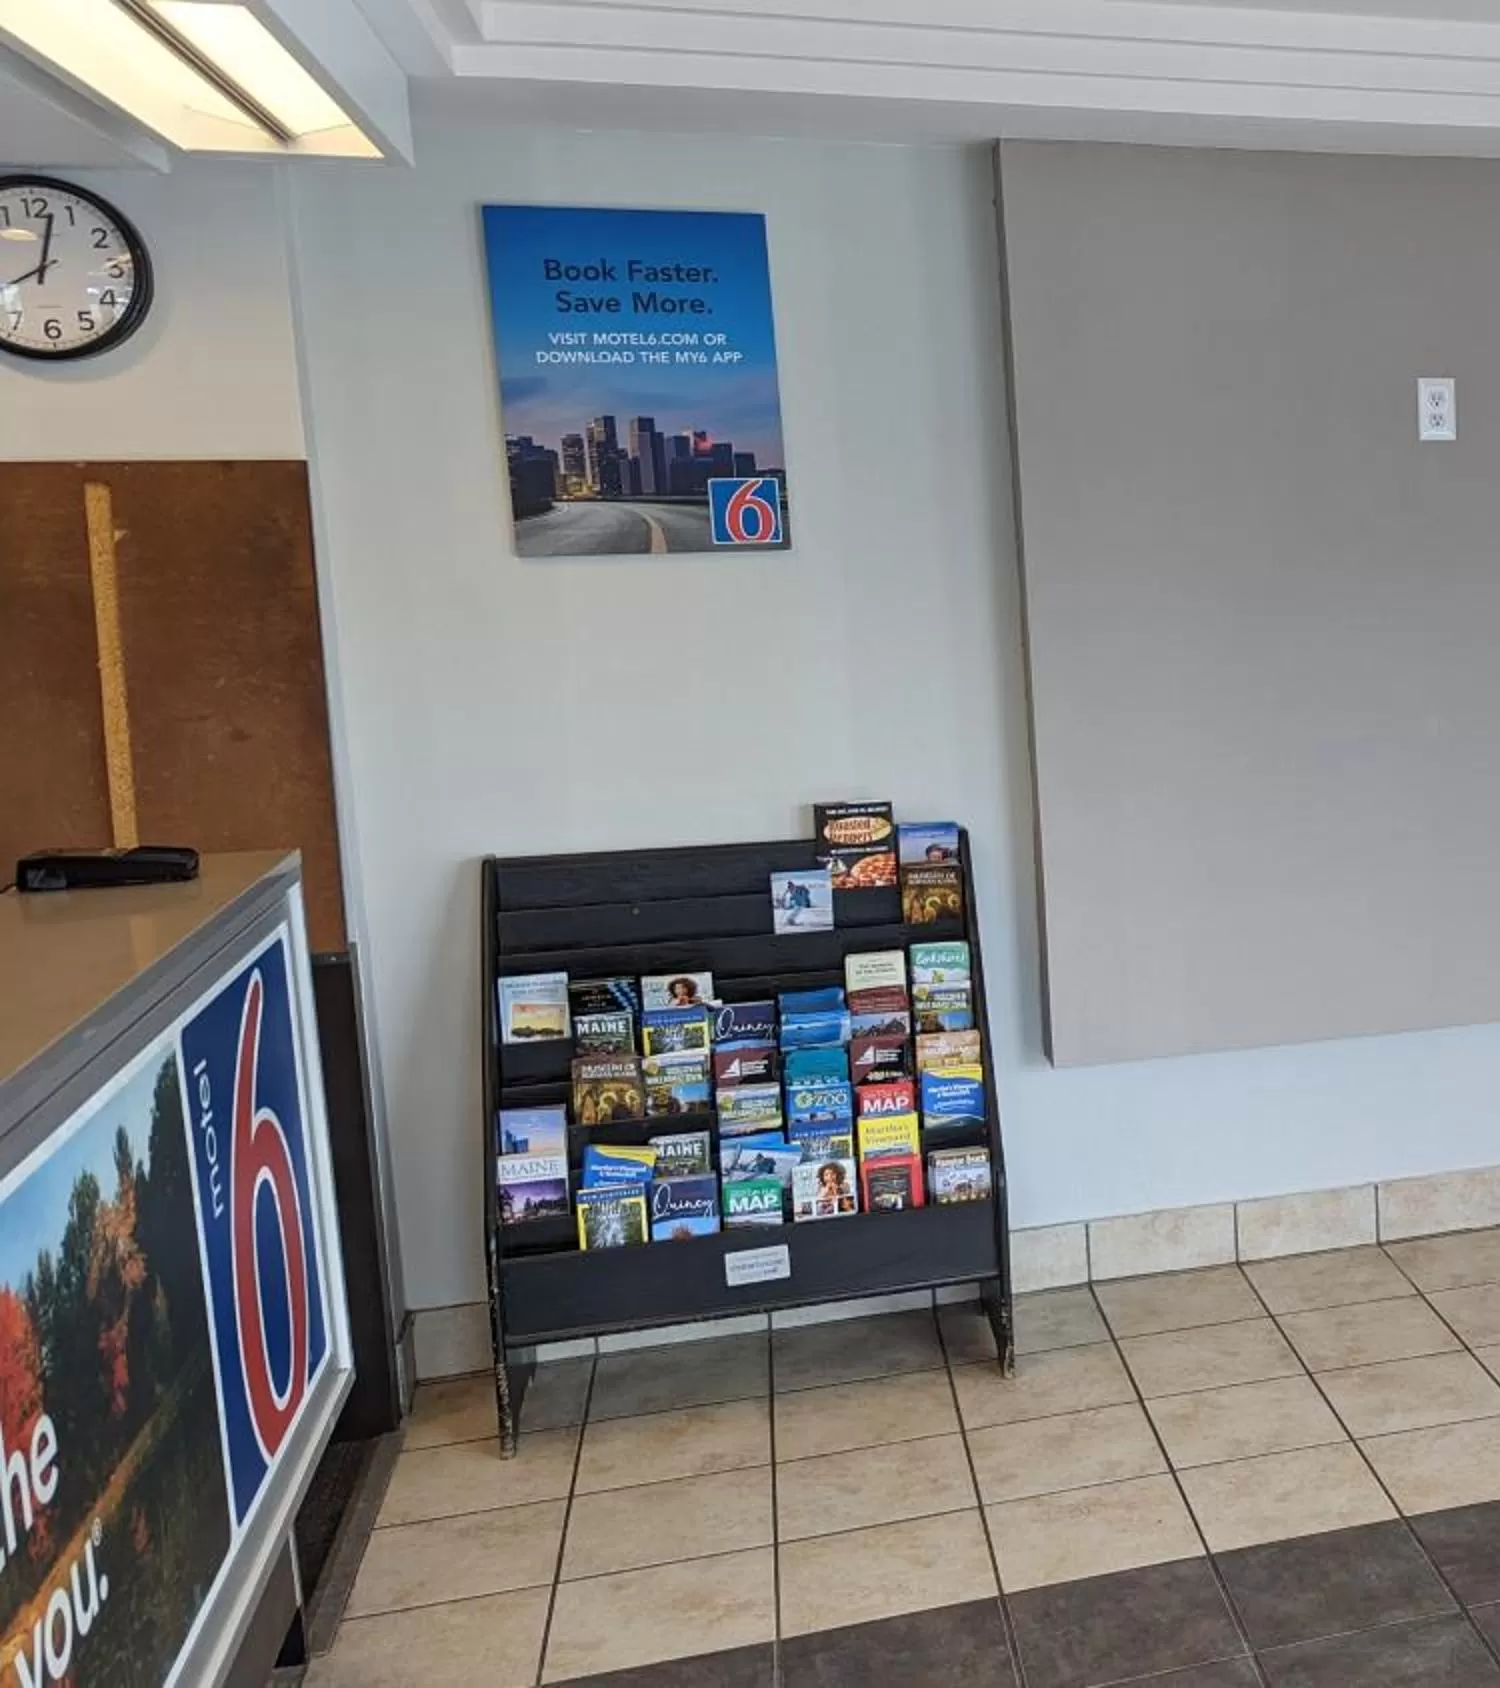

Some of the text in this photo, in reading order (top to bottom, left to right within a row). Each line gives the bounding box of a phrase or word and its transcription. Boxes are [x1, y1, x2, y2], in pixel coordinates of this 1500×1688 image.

[0, 205, 10, 226] 1
[20, 198, 49, 219] 12
[64, 205, 75, 226] 1
[91, 228, 110, 249] 2
[105, 257, 125, 279] 3
[544, 258, 719, 283] Book Faster.
[99, 289, 117, 307] 4
[555, 290, 713, 315] Save More.
[10, 311, 22, 331] 7
[44, 319, 62, 340] 6
[77, 311, 95, 331] 5
[548, 332, 727, 346] VISIT MOTEL6.COM OR
[536, 351, 744, 364] DOWNLOAD THE MY6 APP
[725, 479, 776, 544] 6
[577, 1020, 628, 1036] MAINE
[863, 1094, 910, 1113] MAP
[193, 1057, 225, 1220] motel
[652, 1183, 714, 1219] Quincy
[729, 1192, 778, 1213] MAP
[230, 966, 310, 1468] 6
[0, 1412, 59, 1575] he
